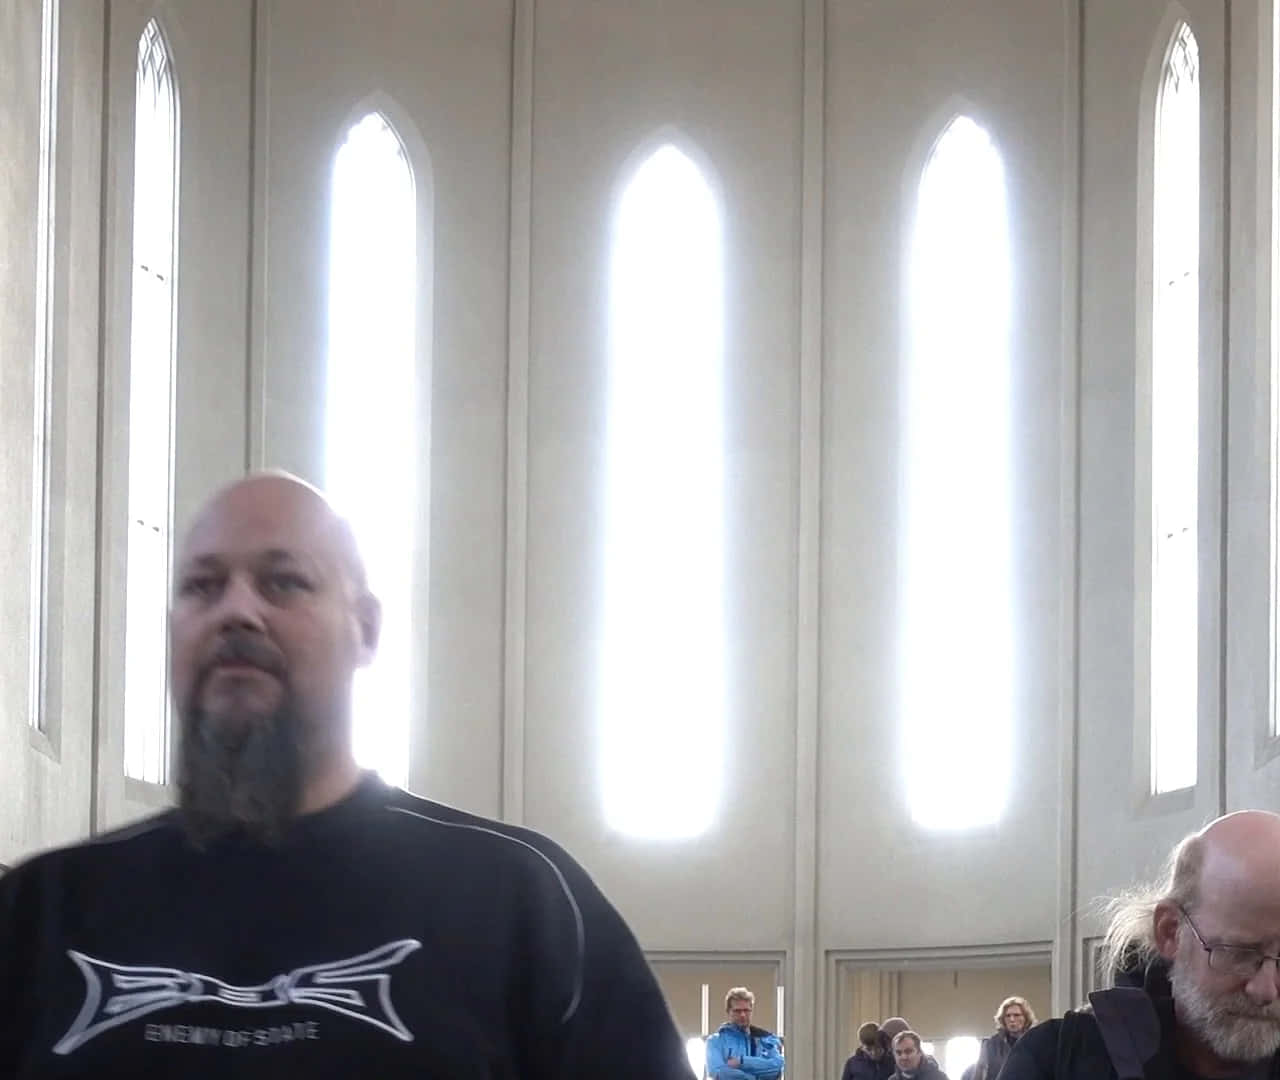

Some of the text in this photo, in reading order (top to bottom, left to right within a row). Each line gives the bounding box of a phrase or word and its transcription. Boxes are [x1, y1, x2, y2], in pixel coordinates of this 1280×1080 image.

[144, 1020, 321, 1048] ENEMY OF STATE
